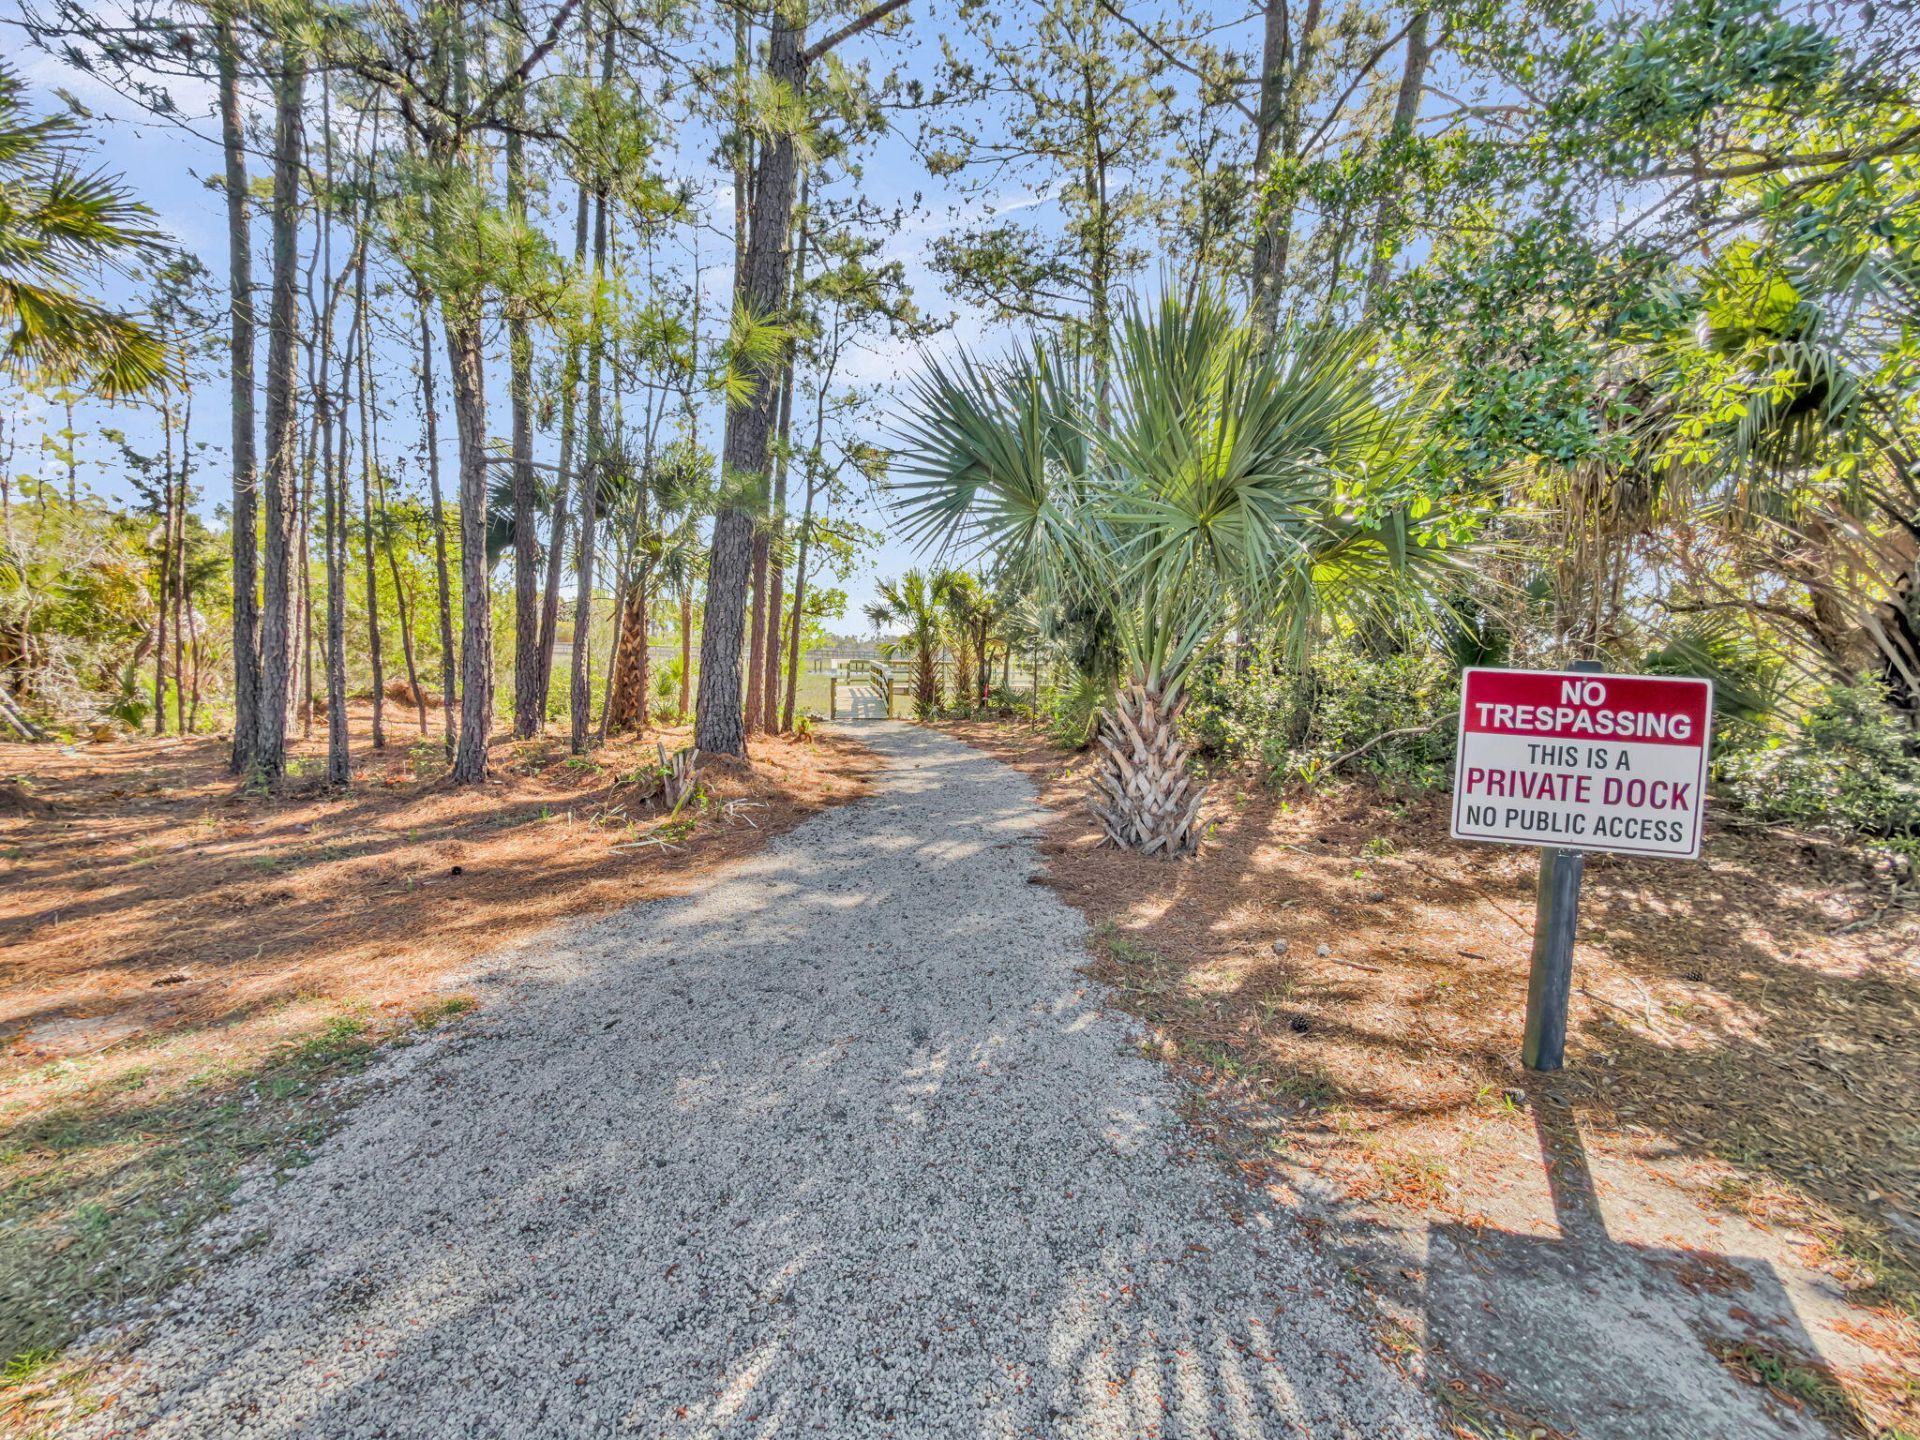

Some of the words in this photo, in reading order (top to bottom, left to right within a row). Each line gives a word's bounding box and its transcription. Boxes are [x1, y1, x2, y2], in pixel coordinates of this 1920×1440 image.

[1561, 681, 1606, 706] NO
[1476, 703, 1691, 739] TRESPASSING
[1528, 744, 1578, 767] THIS
[1587, 748, 1608, 769] IS
[1616, 750, 1630, 770] A
[1466, 767, 1592, 803] PRIVATE
[1603, 777, 1690, 811] DOCK
[1466, 805, 1496, 826] NO
[1506, 809, 1585, 834] PUBLIC
[1593, 816, 1683, 842] ACCESS
